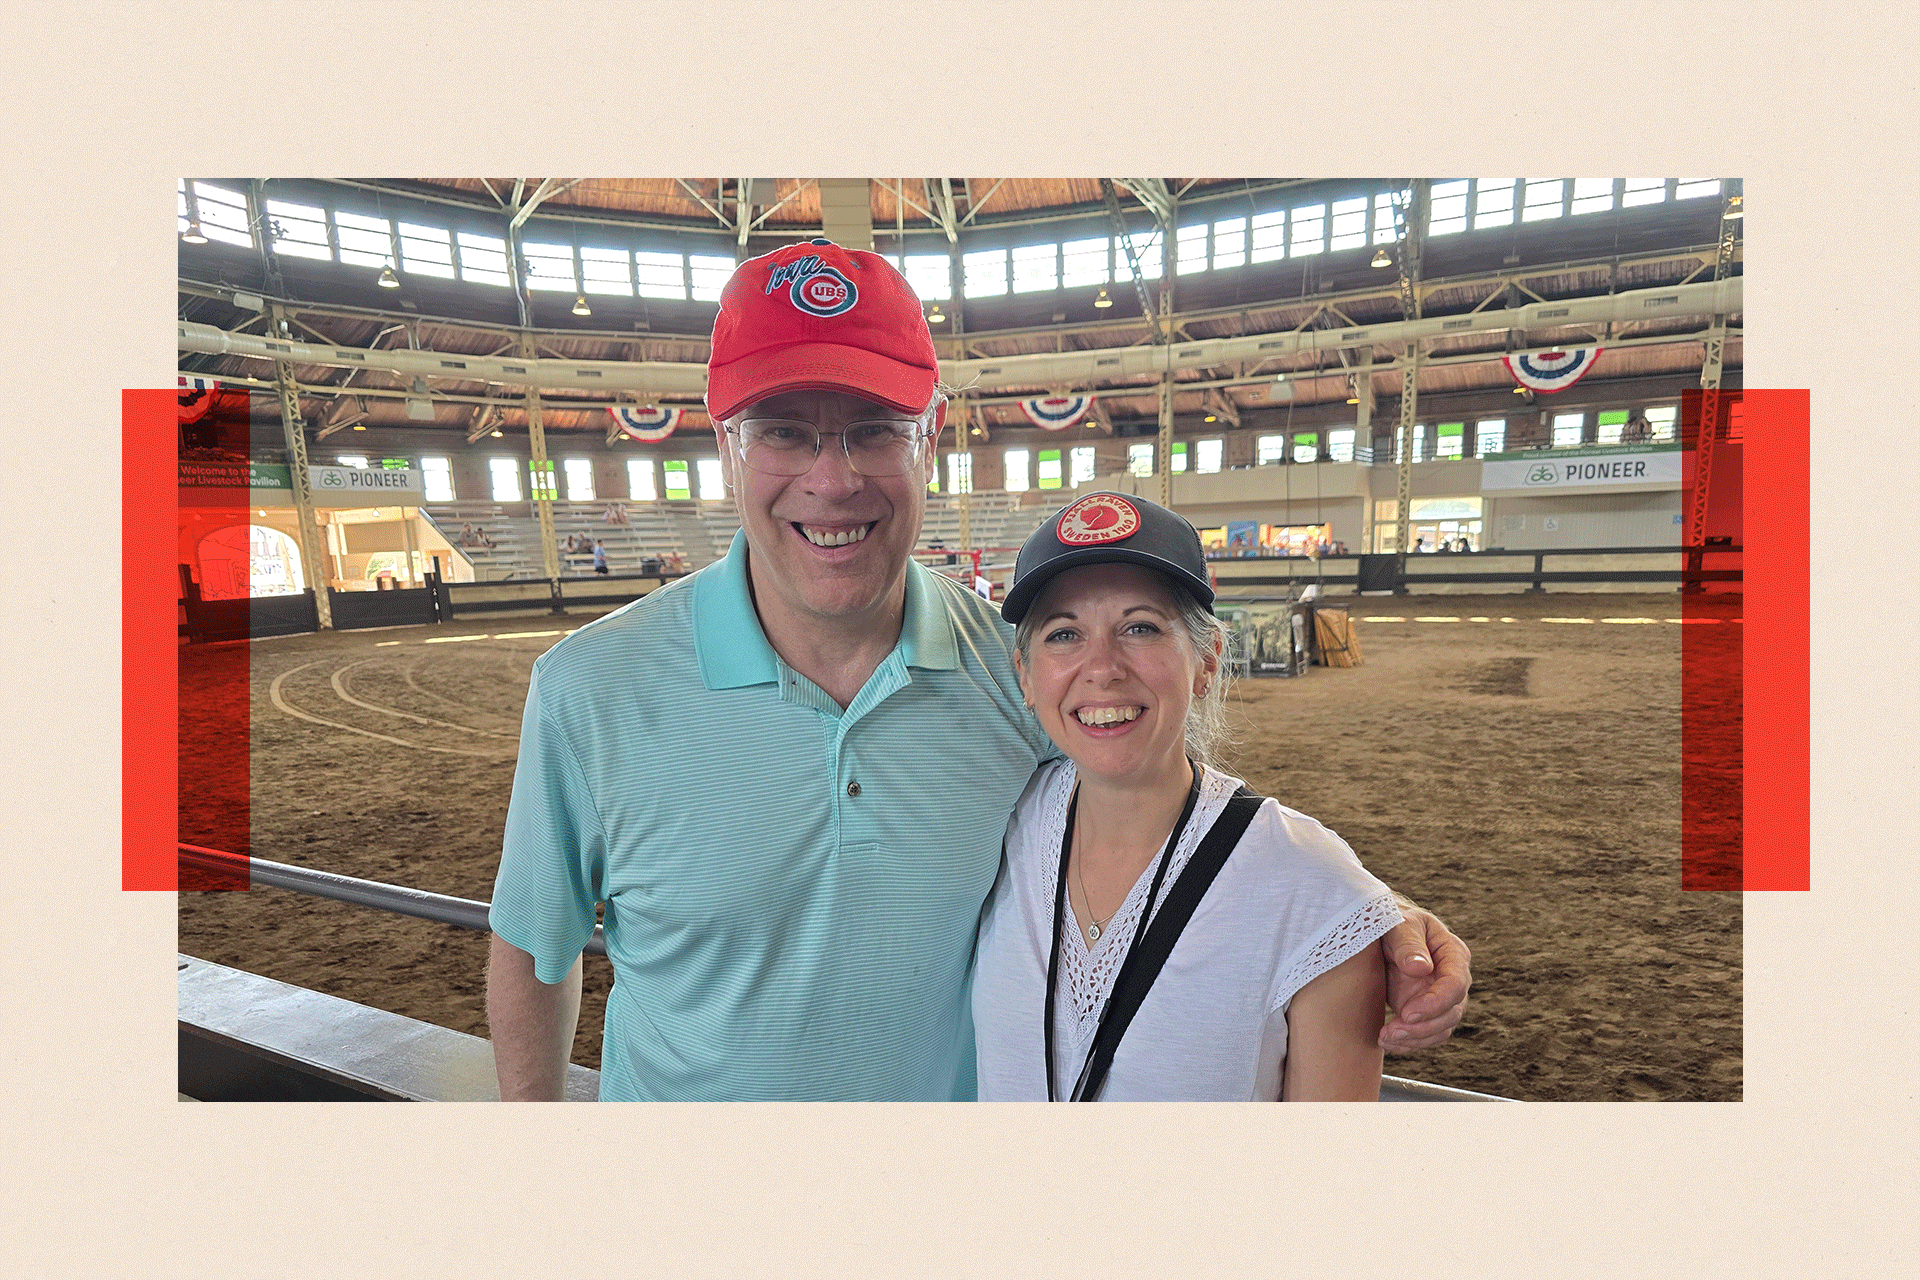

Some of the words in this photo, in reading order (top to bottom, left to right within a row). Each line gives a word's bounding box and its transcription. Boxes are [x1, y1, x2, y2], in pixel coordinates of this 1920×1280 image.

[766, 255, 826, 295] Iowa
[180, 465, 226, 475] Welcome
[228, 467, 239, 475] to
[241, 467, 257, 476] the
[1566, 461, 1646, 480] PIONEER
[198, 475, 242, 485] Livestock
[244, 476, 281, 486] Pavilion
[350, 472, 408, 487] PIONEER
[1063, 526, 1111, 541] SWEDEN
